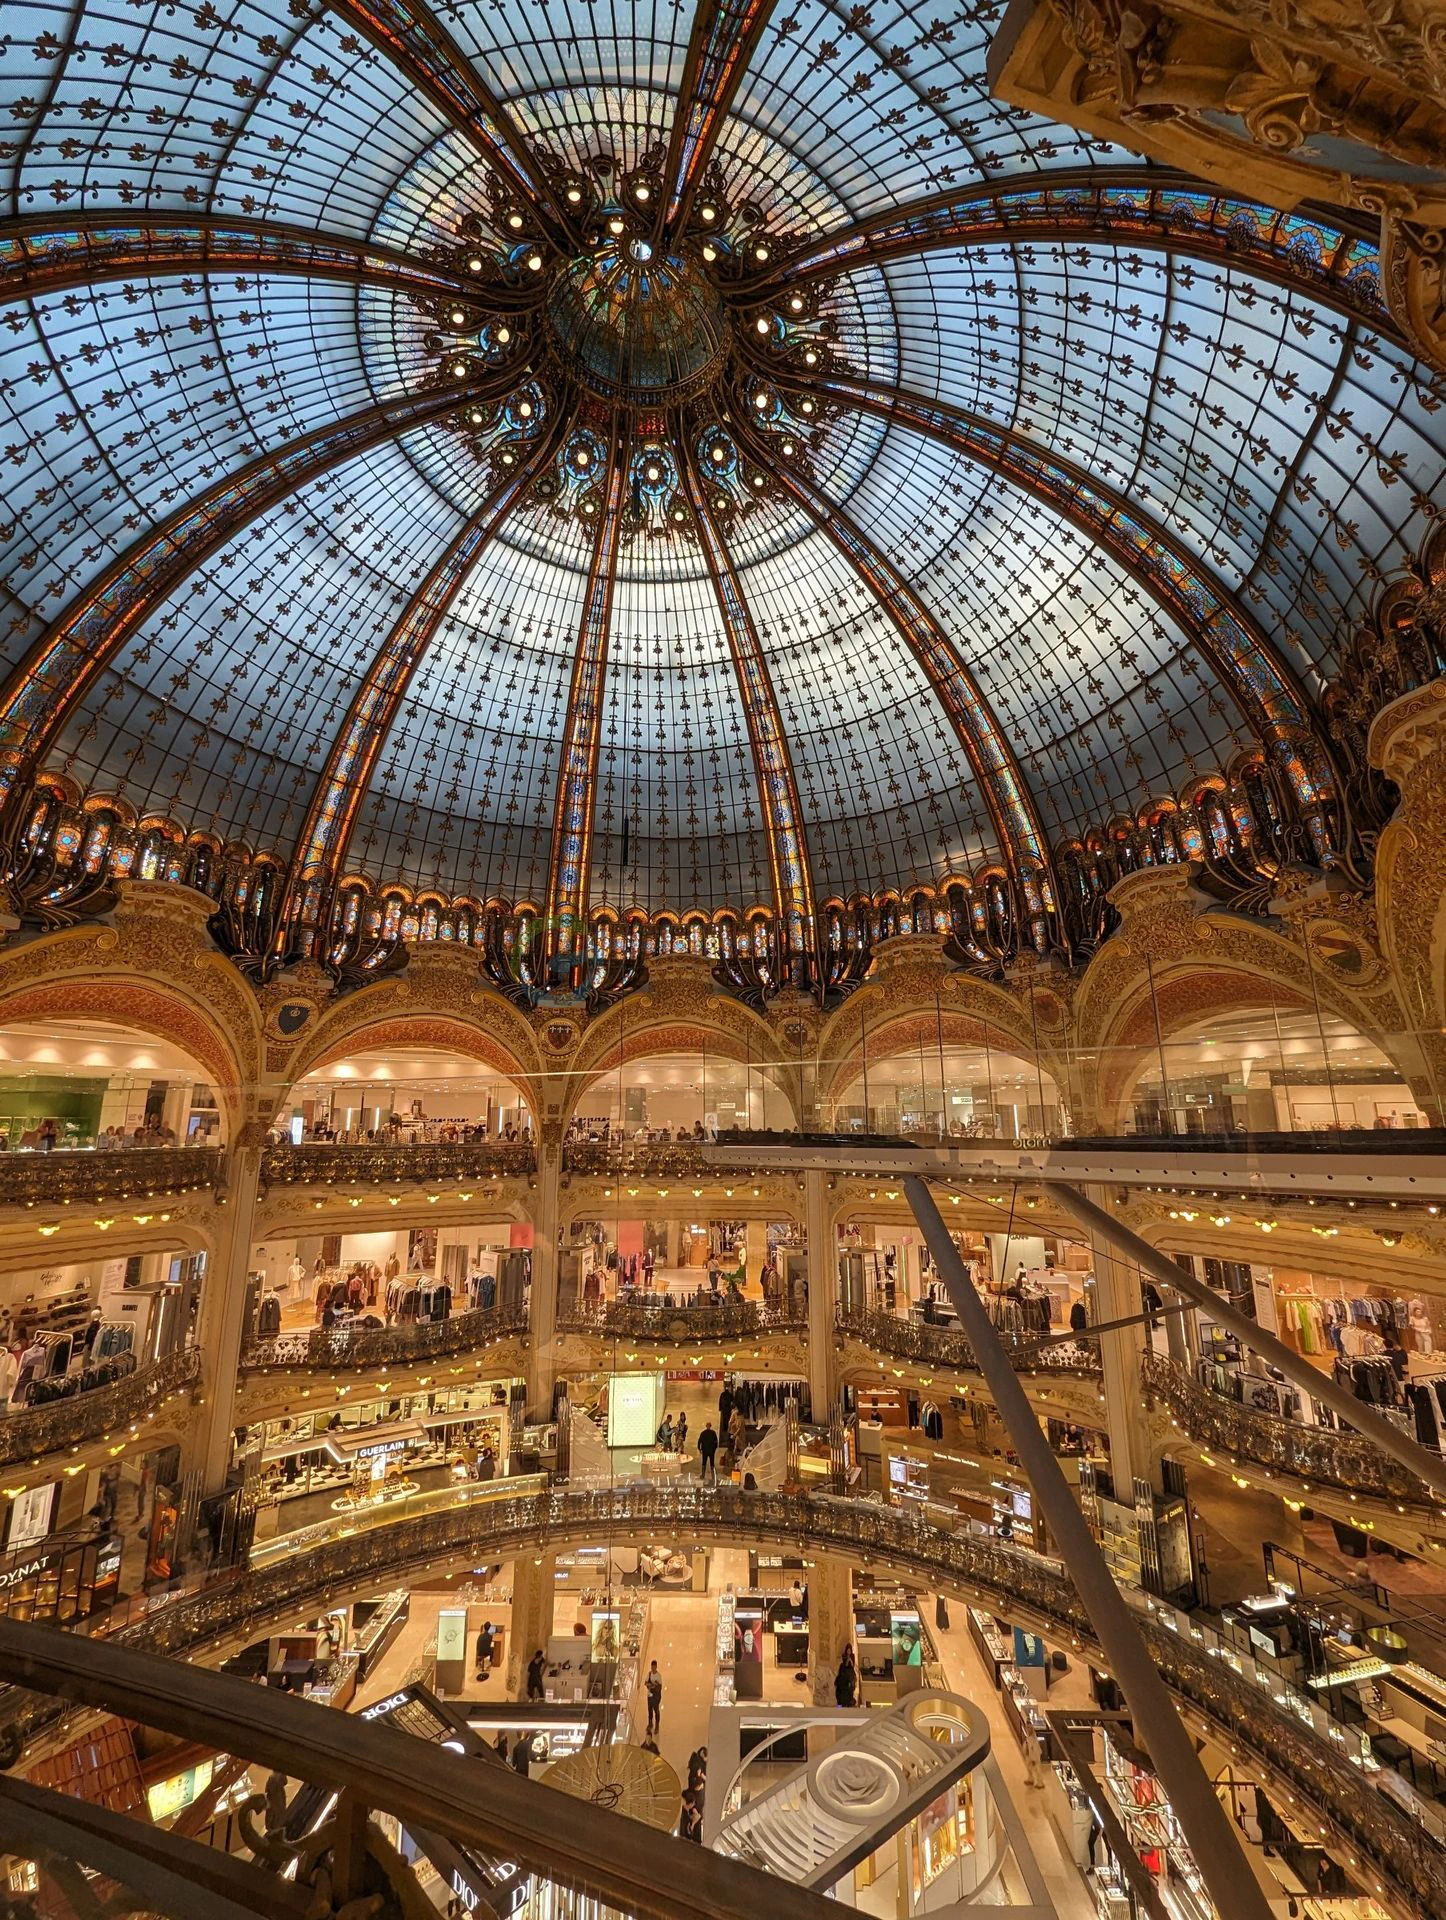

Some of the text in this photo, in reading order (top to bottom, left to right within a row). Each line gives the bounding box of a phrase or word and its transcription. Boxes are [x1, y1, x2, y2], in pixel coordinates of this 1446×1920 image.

[359, 1440, 405, 1458] GUERLAIN
[1169, 1506, 1184, 1518] CHANEL
[0, 1555, 50, 1587] OYNAT
[361, 1693, 408, 1720] DIOR
